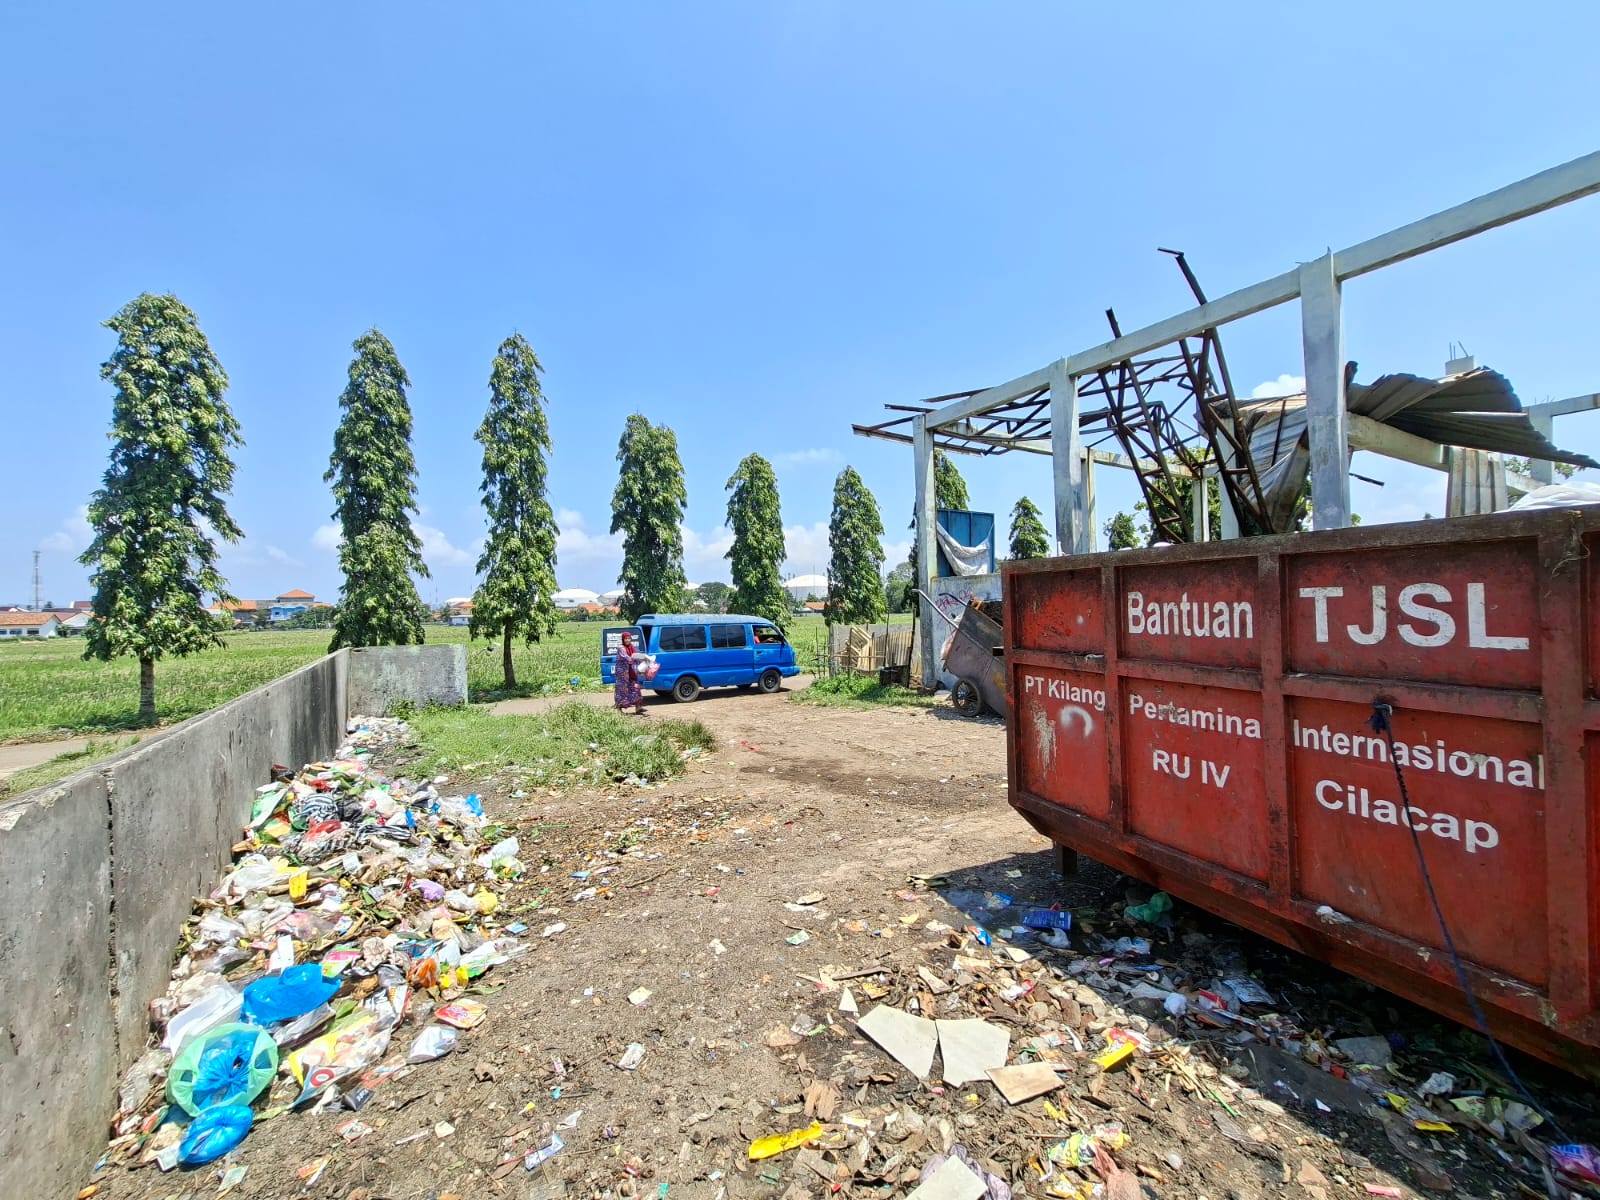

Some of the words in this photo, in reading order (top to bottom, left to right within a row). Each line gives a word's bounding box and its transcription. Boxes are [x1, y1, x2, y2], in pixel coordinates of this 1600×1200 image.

[1128, 592, 1253, 638] Bantuan
[1300, 583, 1529, 650] TJSL
[1025, 675, 1044, 695] PT
[1048, 679, 1105, 711] Kilang
[1129, 694, 1261, 738] Pertamina
[1294, 719, 1544, 789] Internasional
[1153, 750, 1190, 778] RU
[1202, 760, 1230, 788] IV
[1316, 780, 1498, 853] Cilacap
